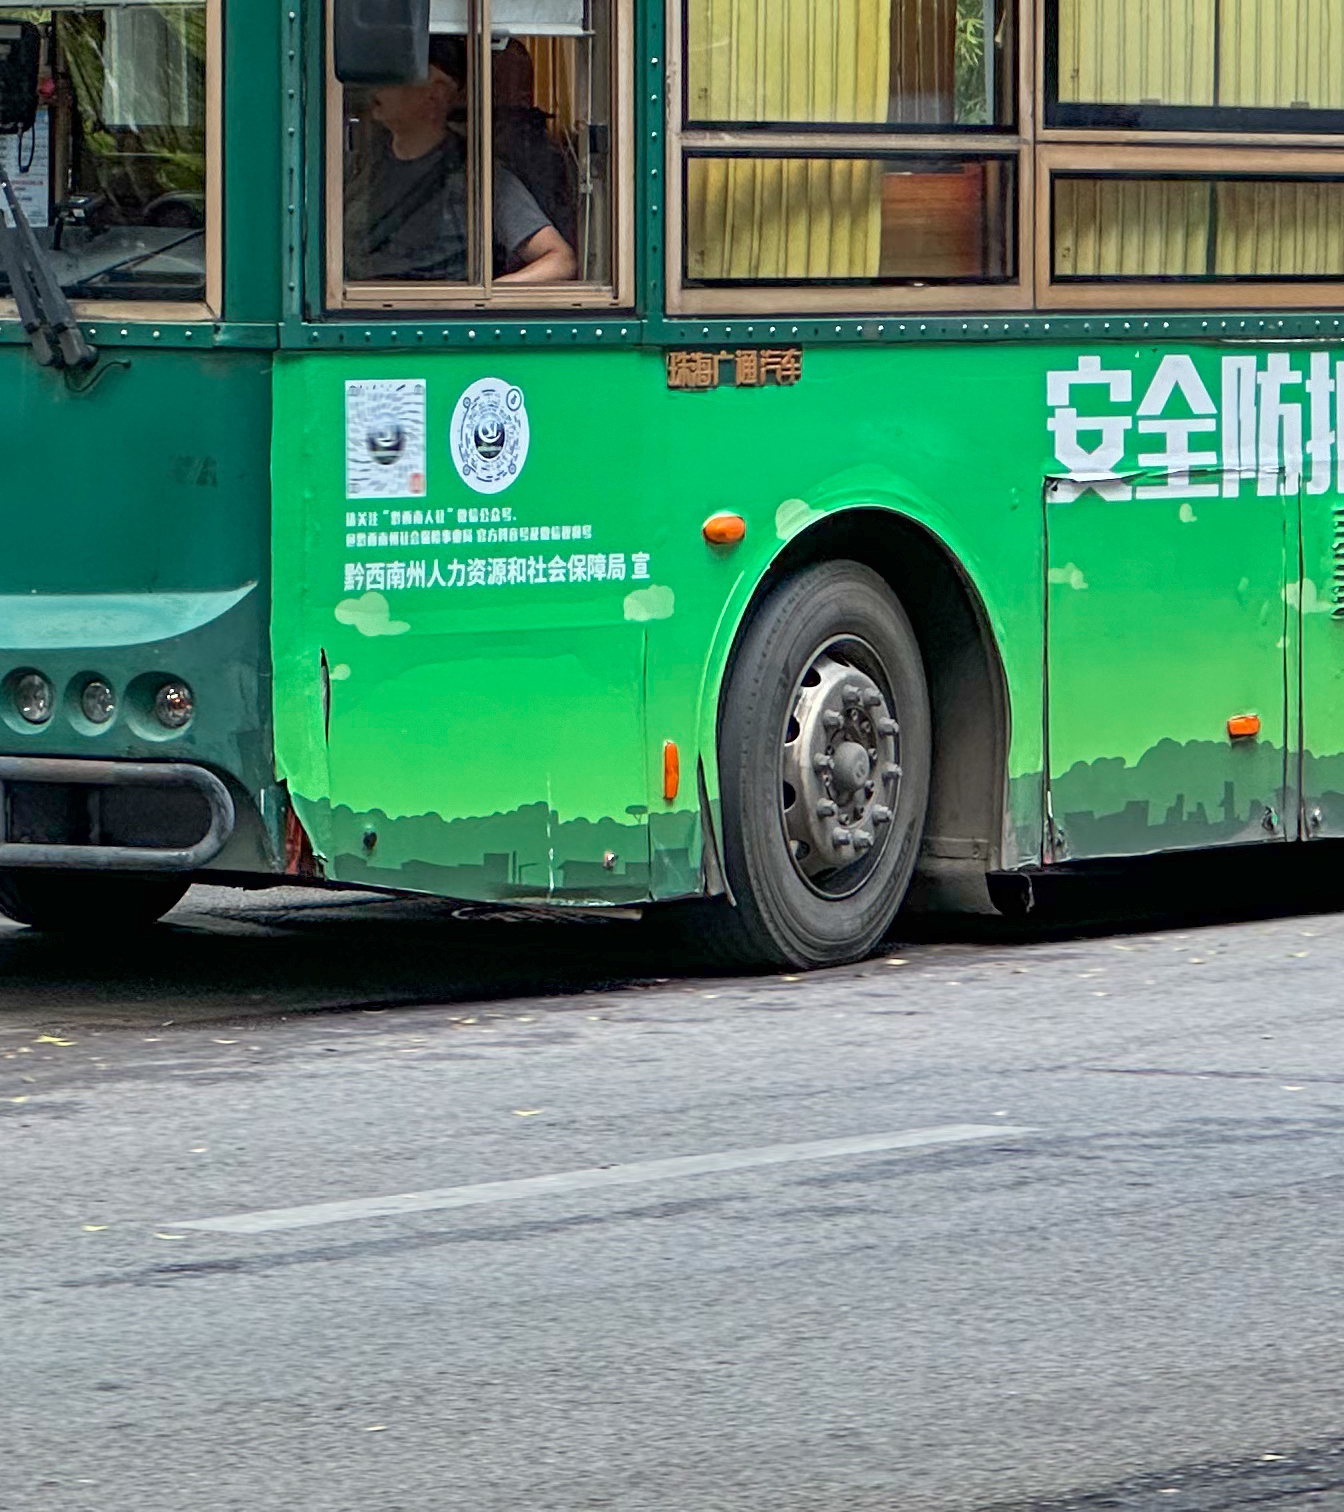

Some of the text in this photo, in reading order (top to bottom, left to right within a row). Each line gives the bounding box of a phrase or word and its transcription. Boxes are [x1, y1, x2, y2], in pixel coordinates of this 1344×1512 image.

[667, 349, 803, 387] 珠海广通汽车
[344, 551, 651, 592] 黔西南州人力资源和社会保障局 宣
